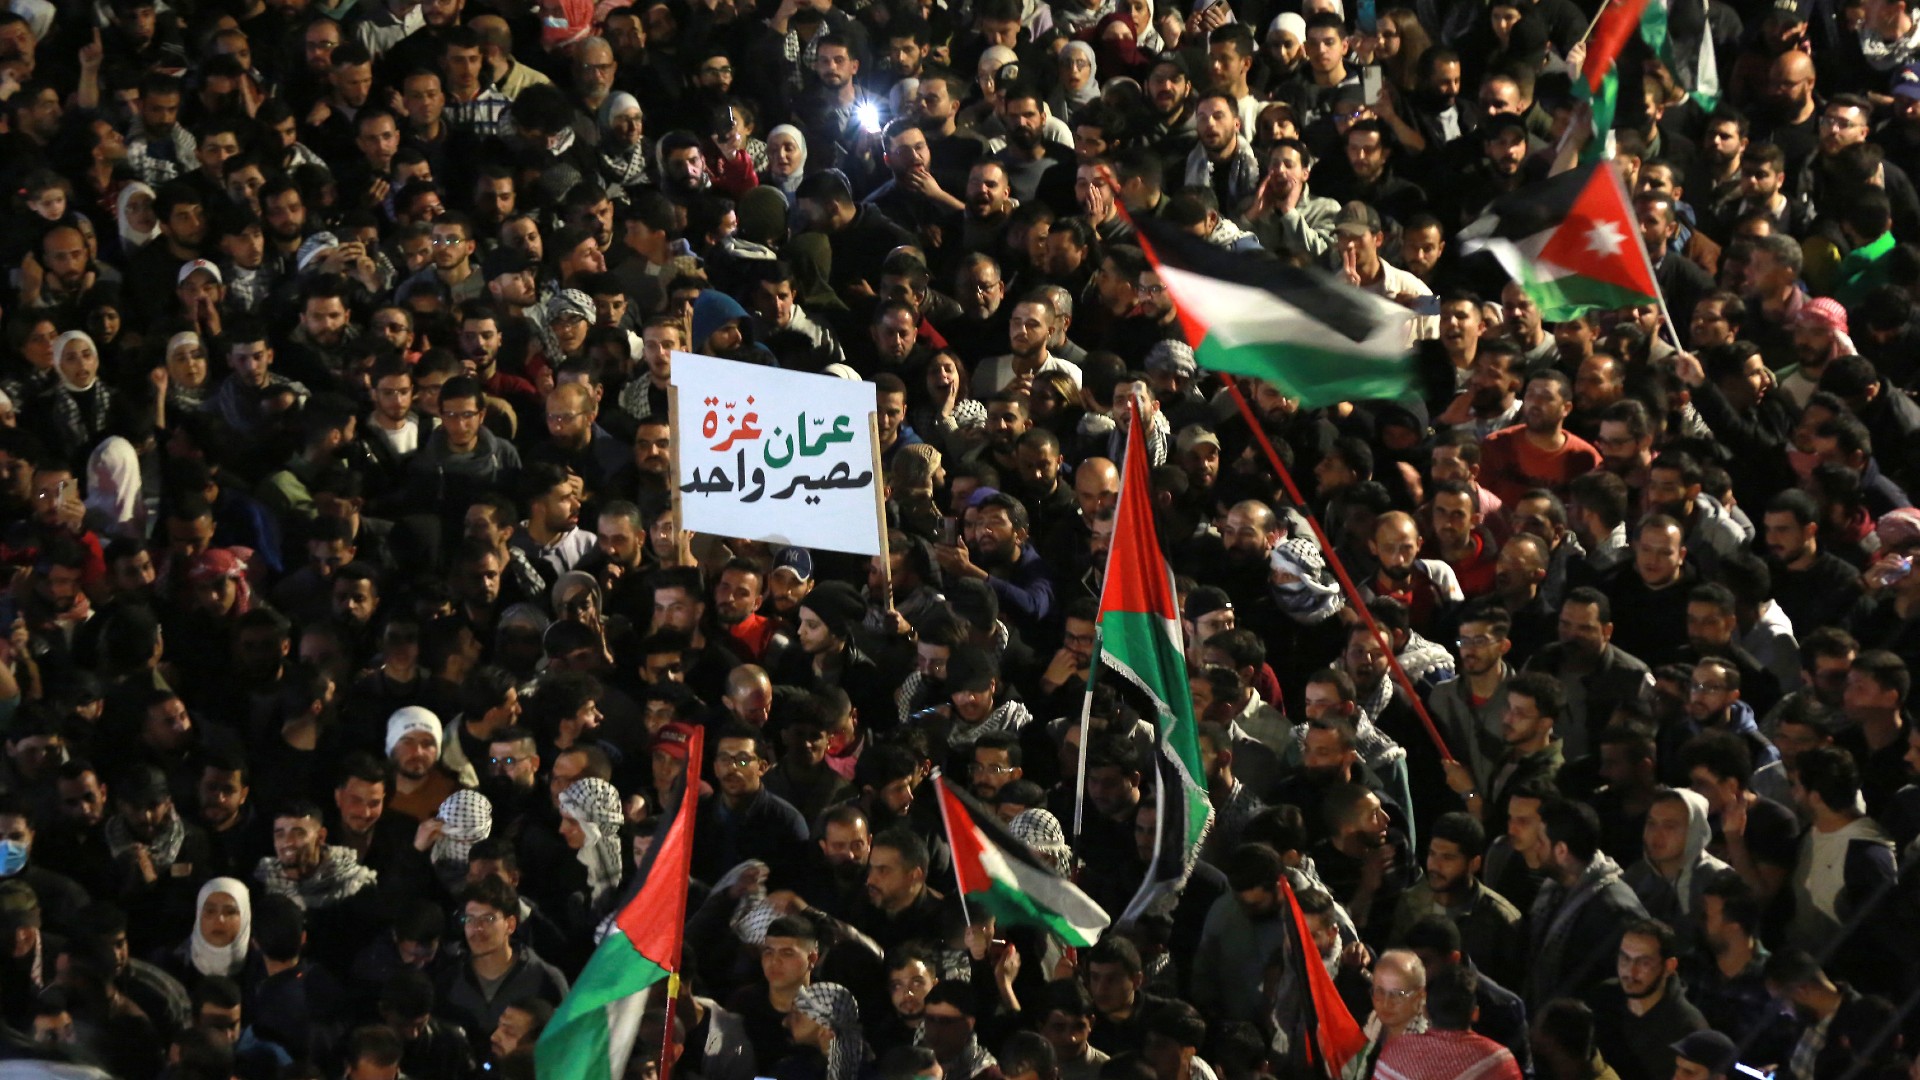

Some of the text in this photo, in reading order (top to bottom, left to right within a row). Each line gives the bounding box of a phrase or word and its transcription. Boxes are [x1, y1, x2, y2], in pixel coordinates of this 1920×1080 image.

[703, 395, 854, 469] عمّان غزّة
[679, 448, 872, 505] مصير واحد
